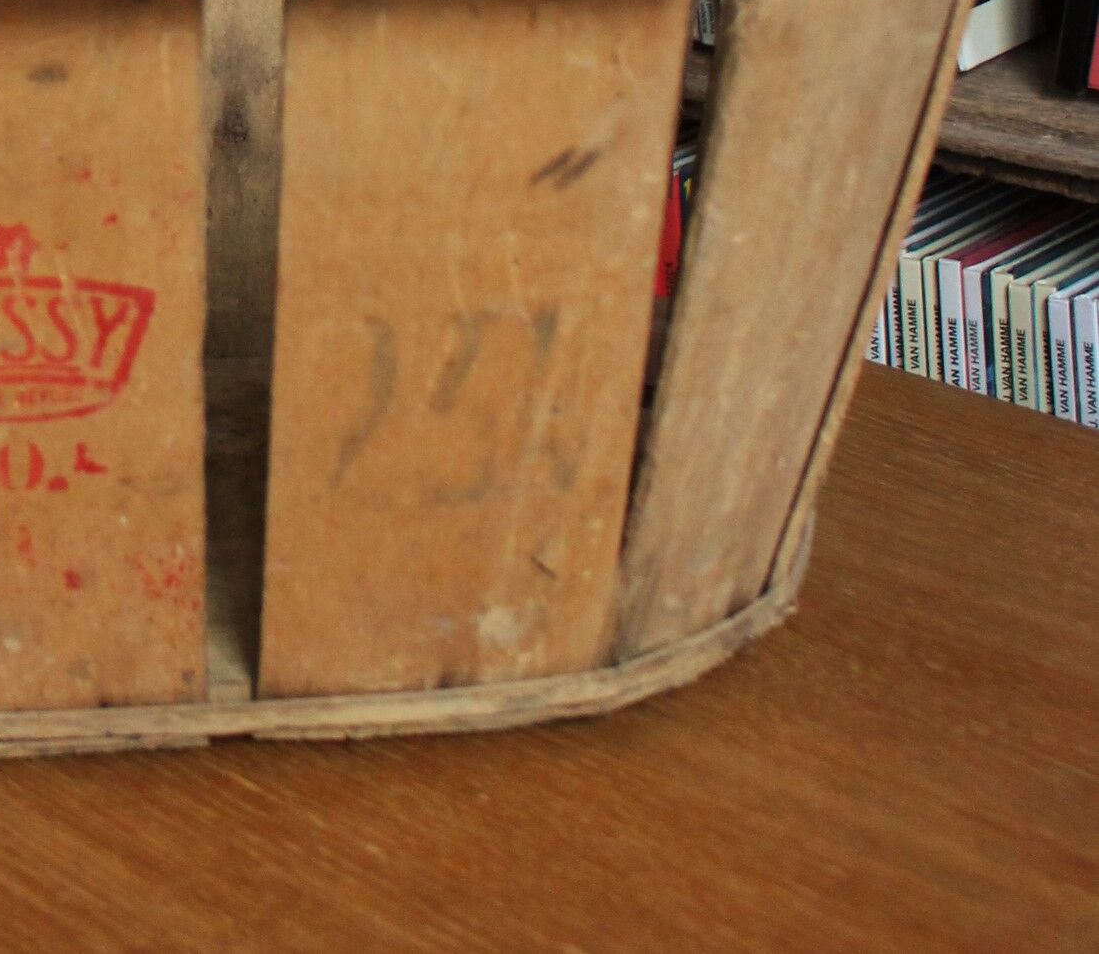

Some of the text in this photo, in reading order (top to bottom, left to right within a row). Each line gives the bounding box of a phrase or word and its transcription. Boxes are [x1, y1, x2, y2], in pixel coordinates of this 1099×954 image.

[870, 336, 880, 360] VAN
[907, 299, 920, 369] VAN HAMME
[948, 318, 960, 386] AN HAMME
[968, 320, 981, 391] VAN HAMME
[999, 318, 1011, 365] HAMME
[1002, 367, 1012, 390] VAN
[1016, 328, 1028, 401] VAN HAMME
[1056, 339, 1069, 413] VAN HAMME
[1084, 342, 1095, 388] HAMME
[1087, 390, 1097, 414] VAN
